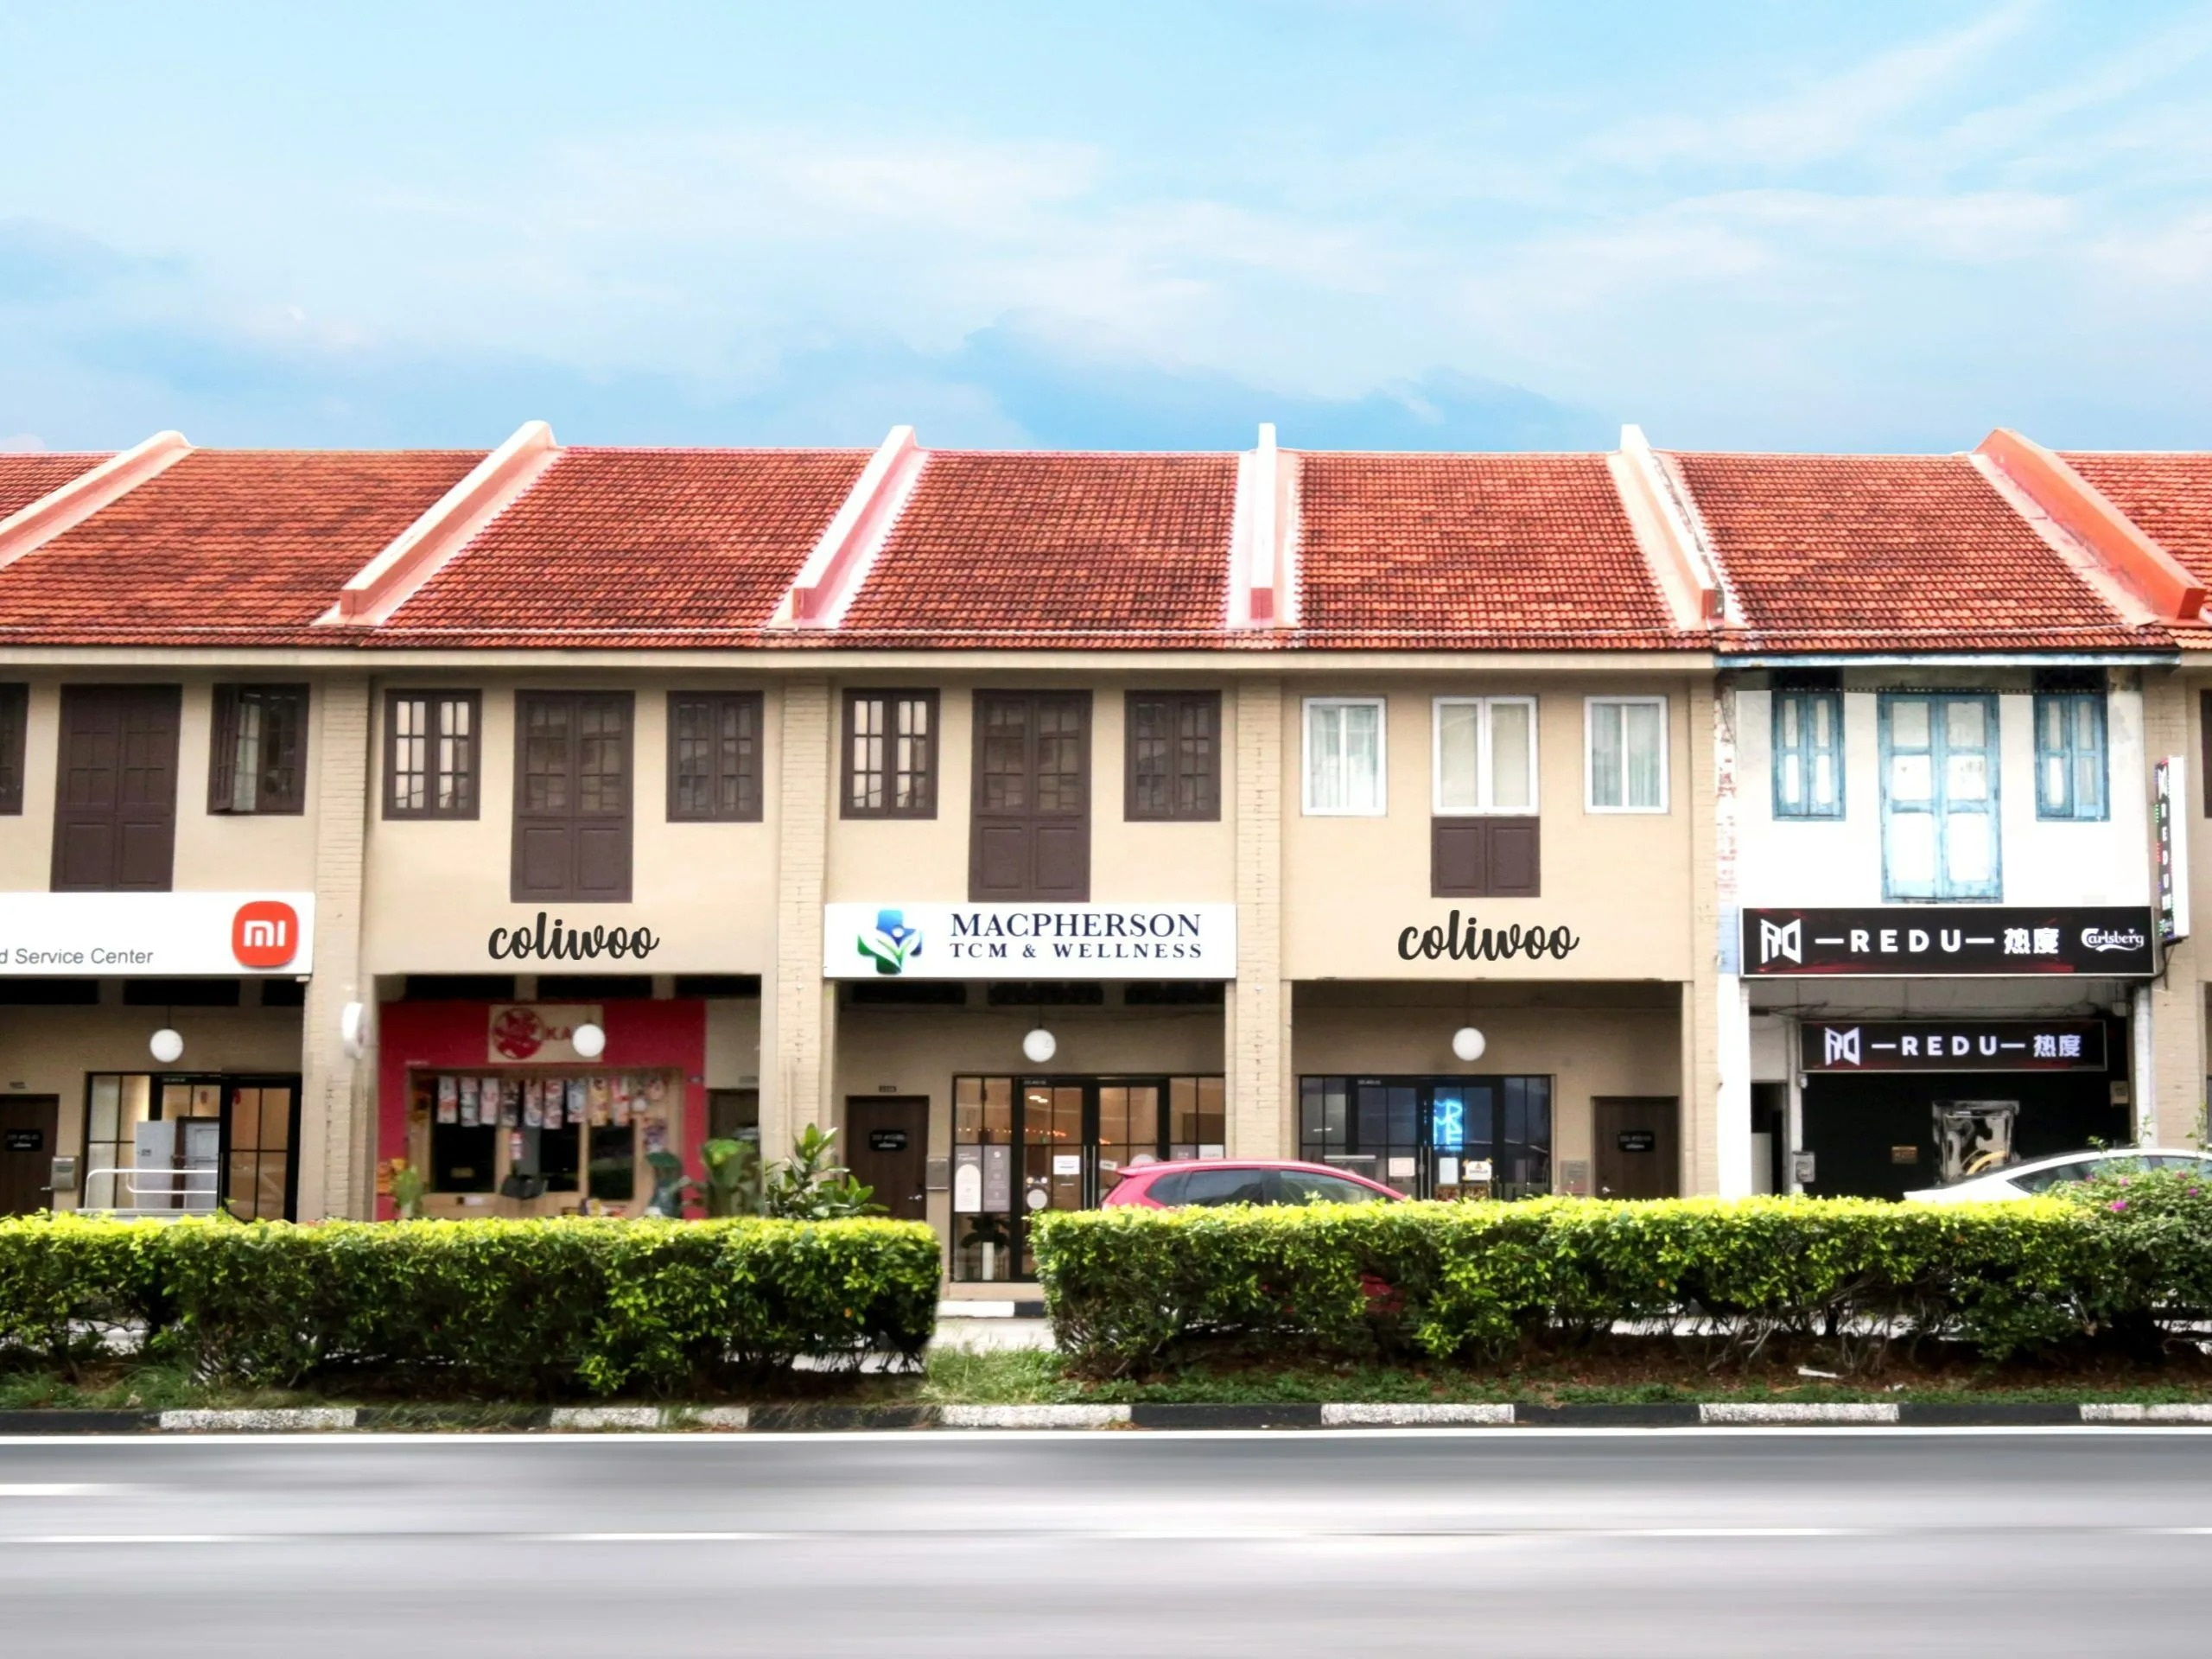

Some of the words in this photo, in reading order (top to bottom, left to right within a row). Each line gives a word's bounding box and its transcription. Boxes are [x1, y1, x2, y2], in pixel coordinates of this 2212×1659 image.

[488, 912, 660, 961] coliwoo
[950, 912, 1201, 938] MACPHERSON
[1397, 909, 1580, 962] coliwoo
[950, 943, 1007, 958] TCM
[1022, 943, 1037, 958] &
[1052, 943, 1202, 958] WELLNESS
[2003, 927, 2060, 955] 热度
[2081, 927, 2145, 952] Carlsberg
[15, 947, 85, 965] Service
[91, 947, 154, 964] Center
[2033, 1034, 2082, 1058] 热度
